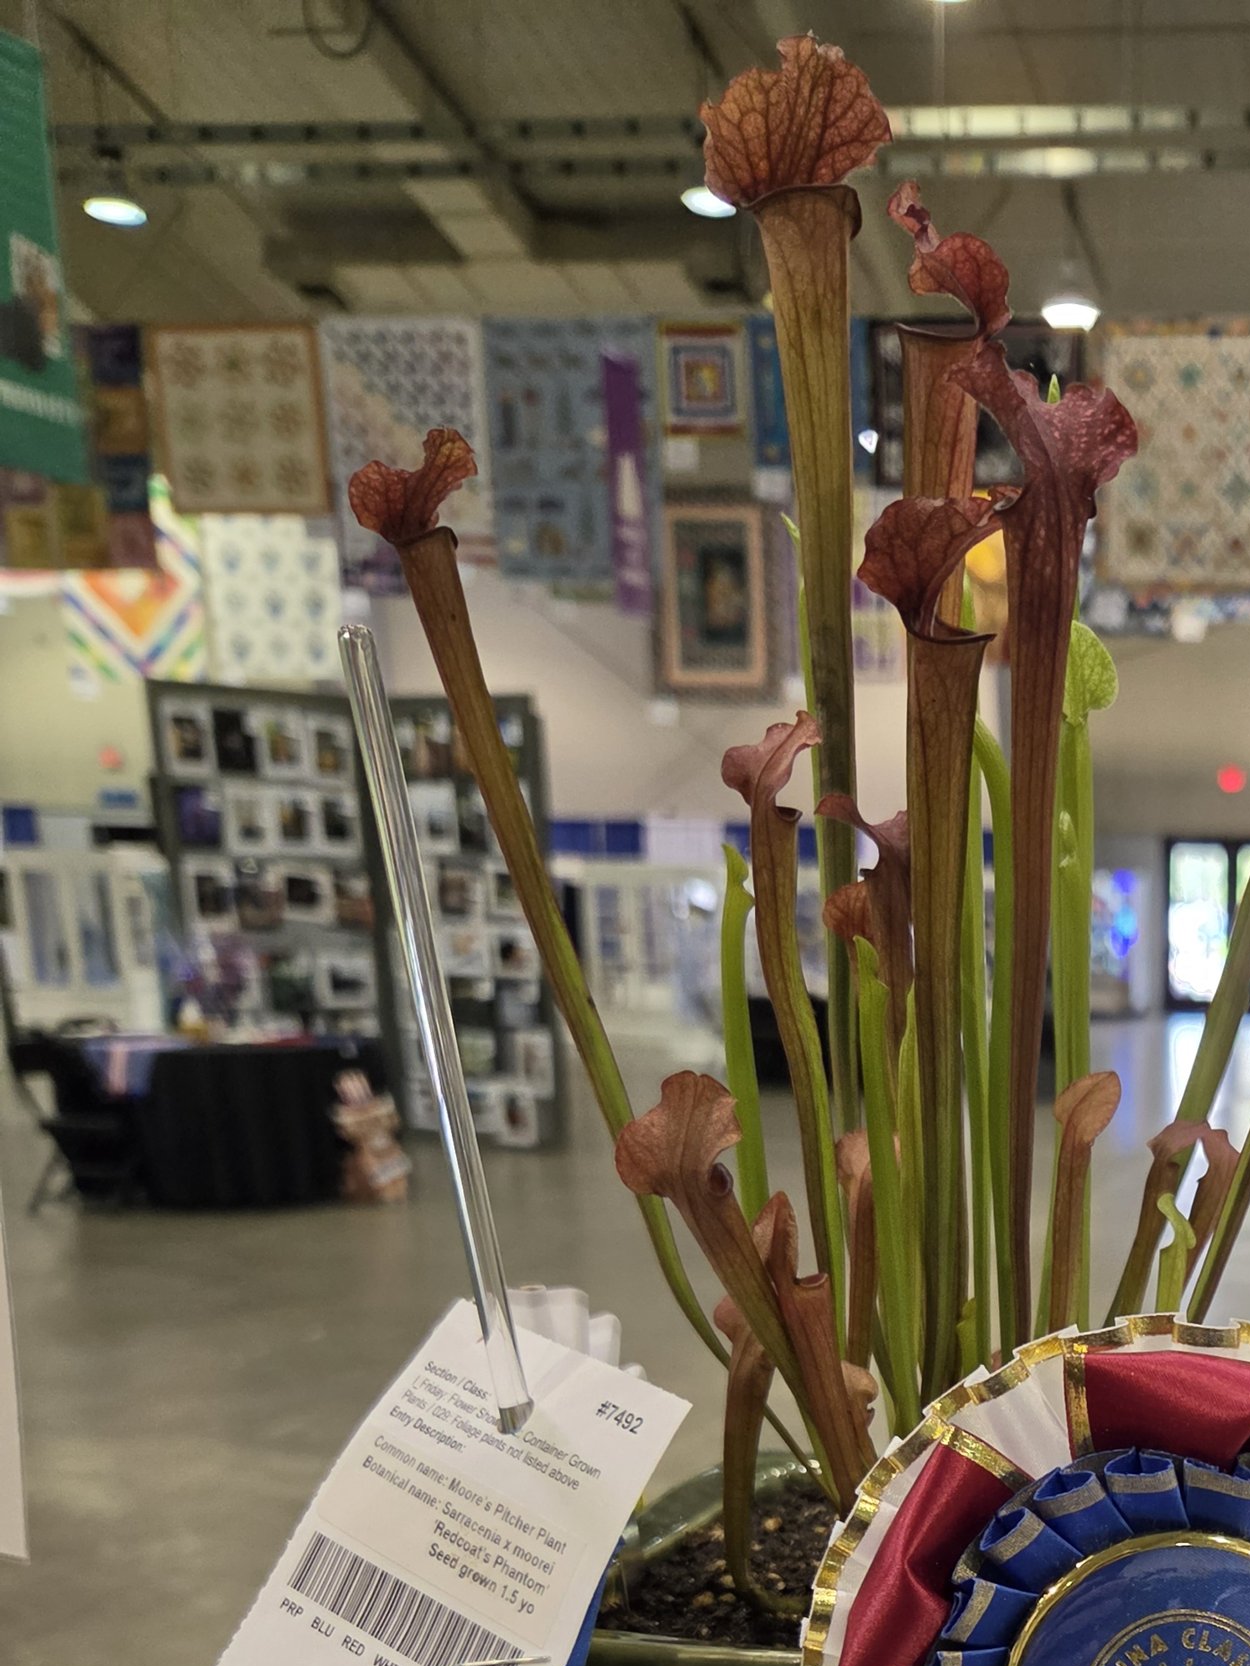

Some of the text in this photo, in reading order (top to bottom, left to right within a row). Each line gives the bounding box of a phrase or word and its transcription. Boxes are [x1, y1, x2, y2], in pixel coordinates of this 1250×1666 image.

[424, 1360, 458, 1386] Section
[462, 1379, 493, 1402] Class:
[595, 1400, 644, 1434] #7492
[389, 1405, 467, 1453] Entry Description:
[401, 1390, 428, 1413] Plants
[451, 1415, 482, 1440] Foliage
[479, 1432, 507, 1453] plants
[506, 1445, 523, 1462] not
[522, 1451, 549, 1475] listed
[548, 1466, 580, 1491] above
[448, 1393, 477, 1415] Flower
[523, 1430, 569, 1462] Container
[568, 1454, 602, 1480] Grown
[362, 1455, 555, 1576] Botanical name: Sarracenia x moorei
[373, 1434, 567, 1555] Common name: Moore's Pitcher Plant
[428, 1543, 536, 1616] Seed grown 1.5 yo
[279, 1597, 305, 1618] PRP
[310, 1616, 336, 1639] BLU
[341, 1634, 366, 1658] RED
